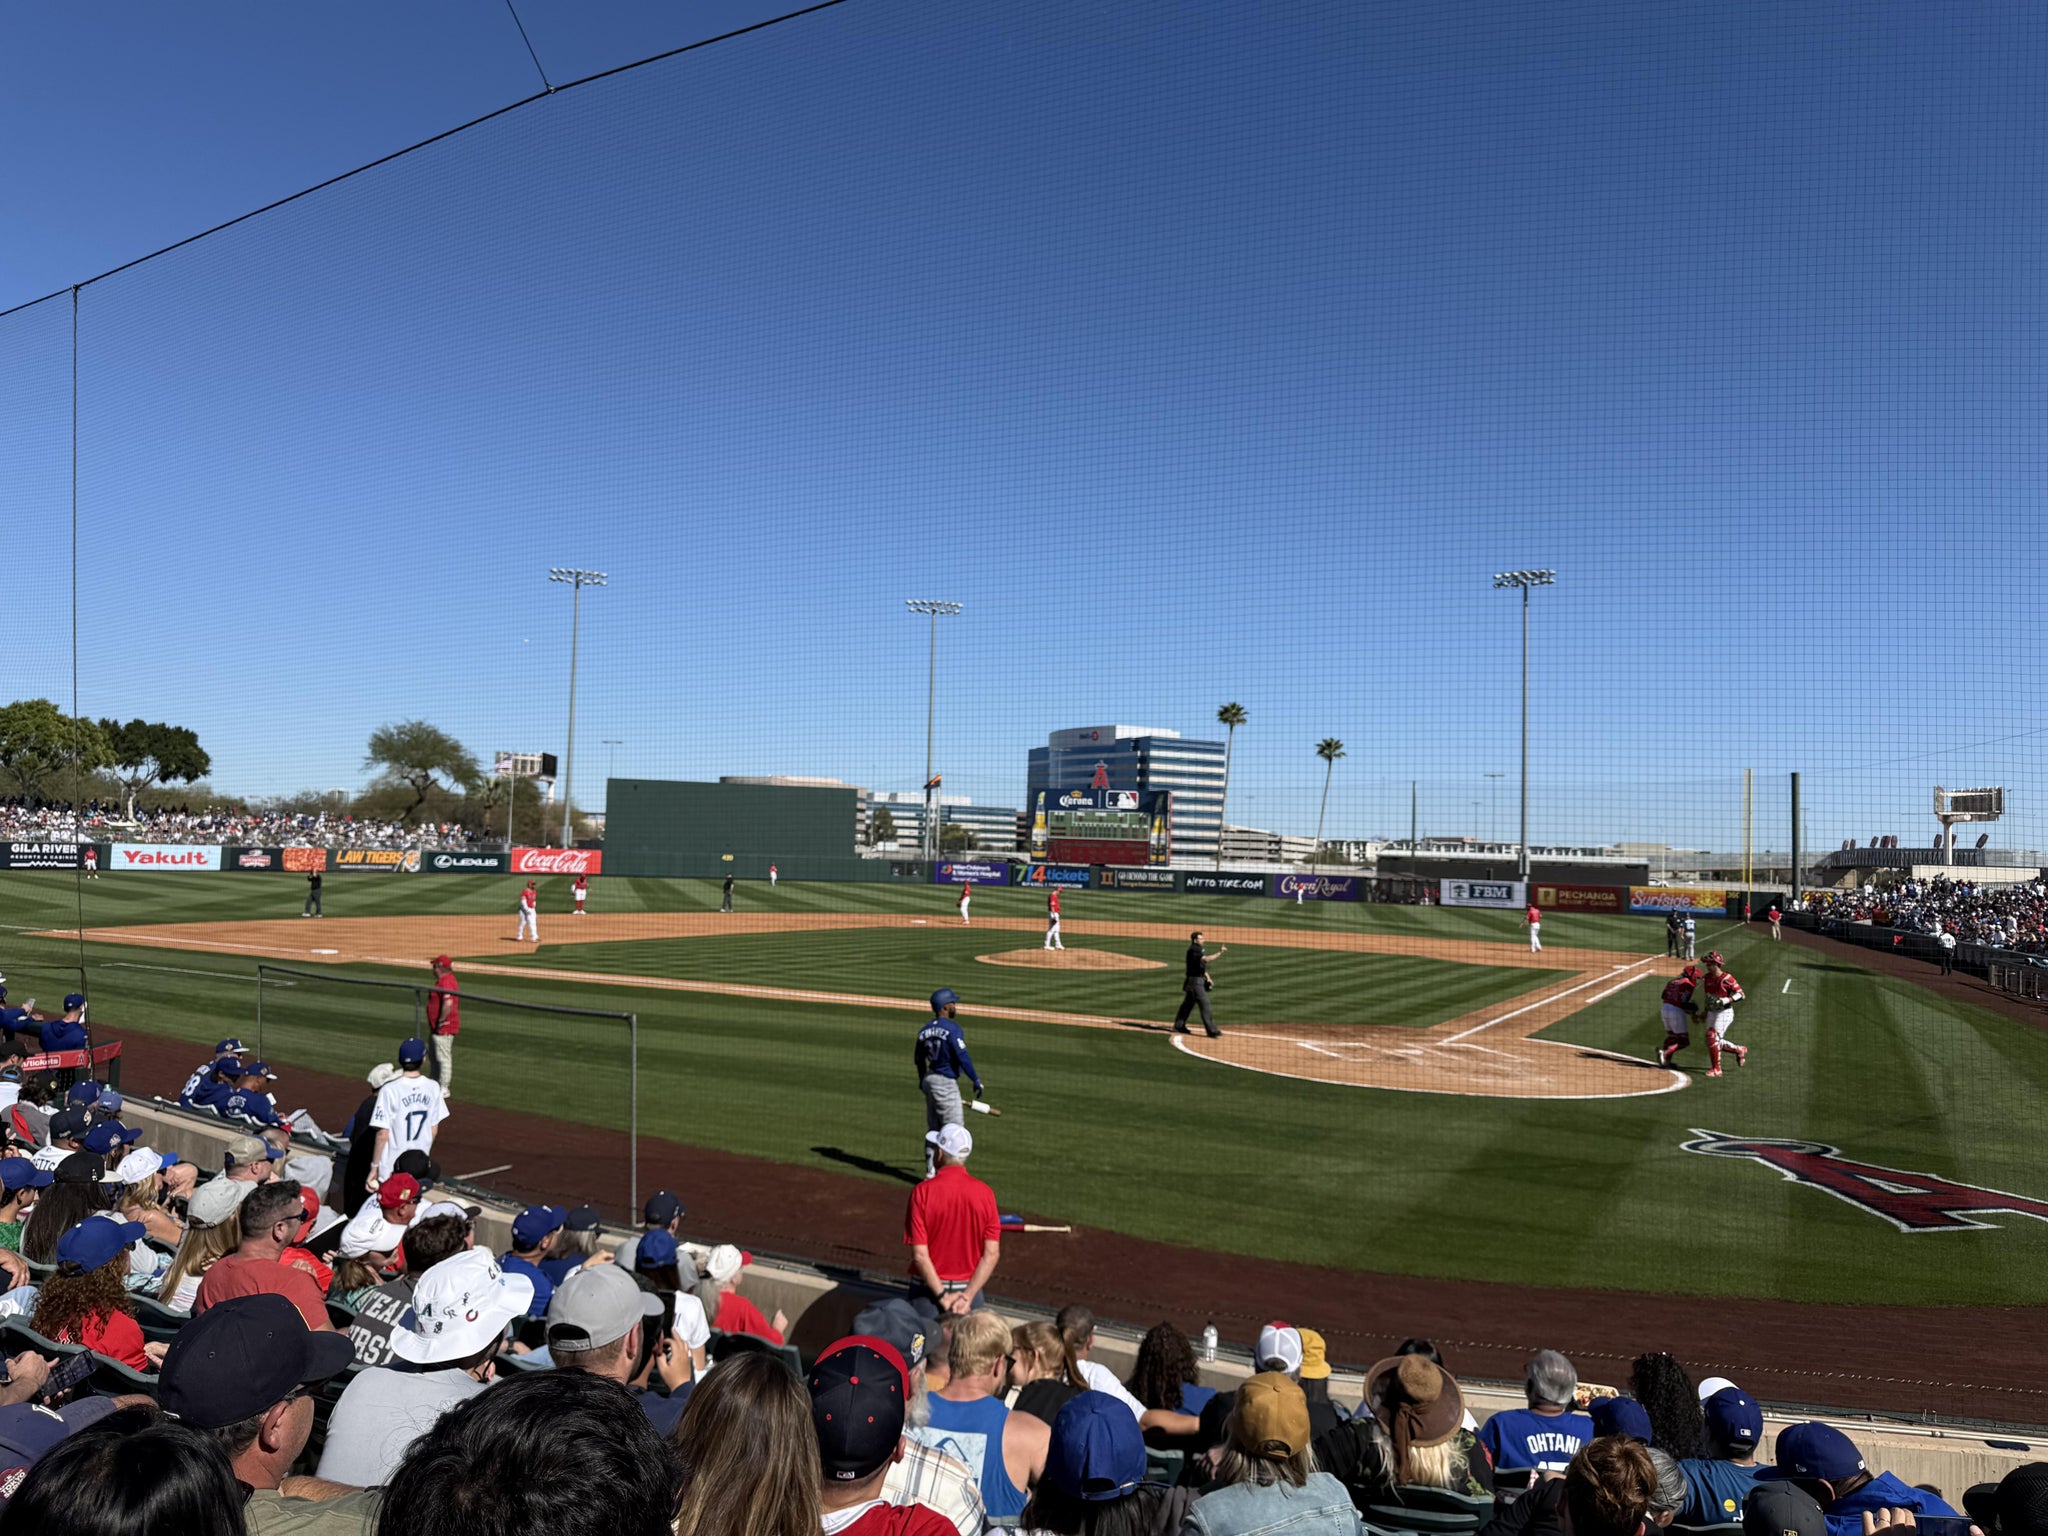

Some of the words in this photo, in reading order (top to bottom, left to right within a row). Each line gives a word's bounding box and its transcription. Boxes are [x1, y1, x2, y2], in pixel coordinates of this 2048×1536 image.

[1059, 794, 1093, 807] Corona
[11, 843, 40, 853] GILA
[42, 843, 77, 854] RIVER
[123, 850, 209, 865] Yakult
[336, 850, 364, 864] LAW
[366, 851, 404, 864] TIGERS
[453, 858, 498, 867] LEXUS
[1186, 876, 1216, 887] NITTO
[1218, 879, 1264, 890] TIRE.COM
[1473, 886, 1508, 898] FBM
[1559, 890, 1617, 900] PECHANGA
[1631, 890, 1690, 908] Surfside
[23, 1058, 59, 1067] /tickets
[405, 1110, 428, 1142] 17
[1527, 1433, 1581, 1455] OHTANI
